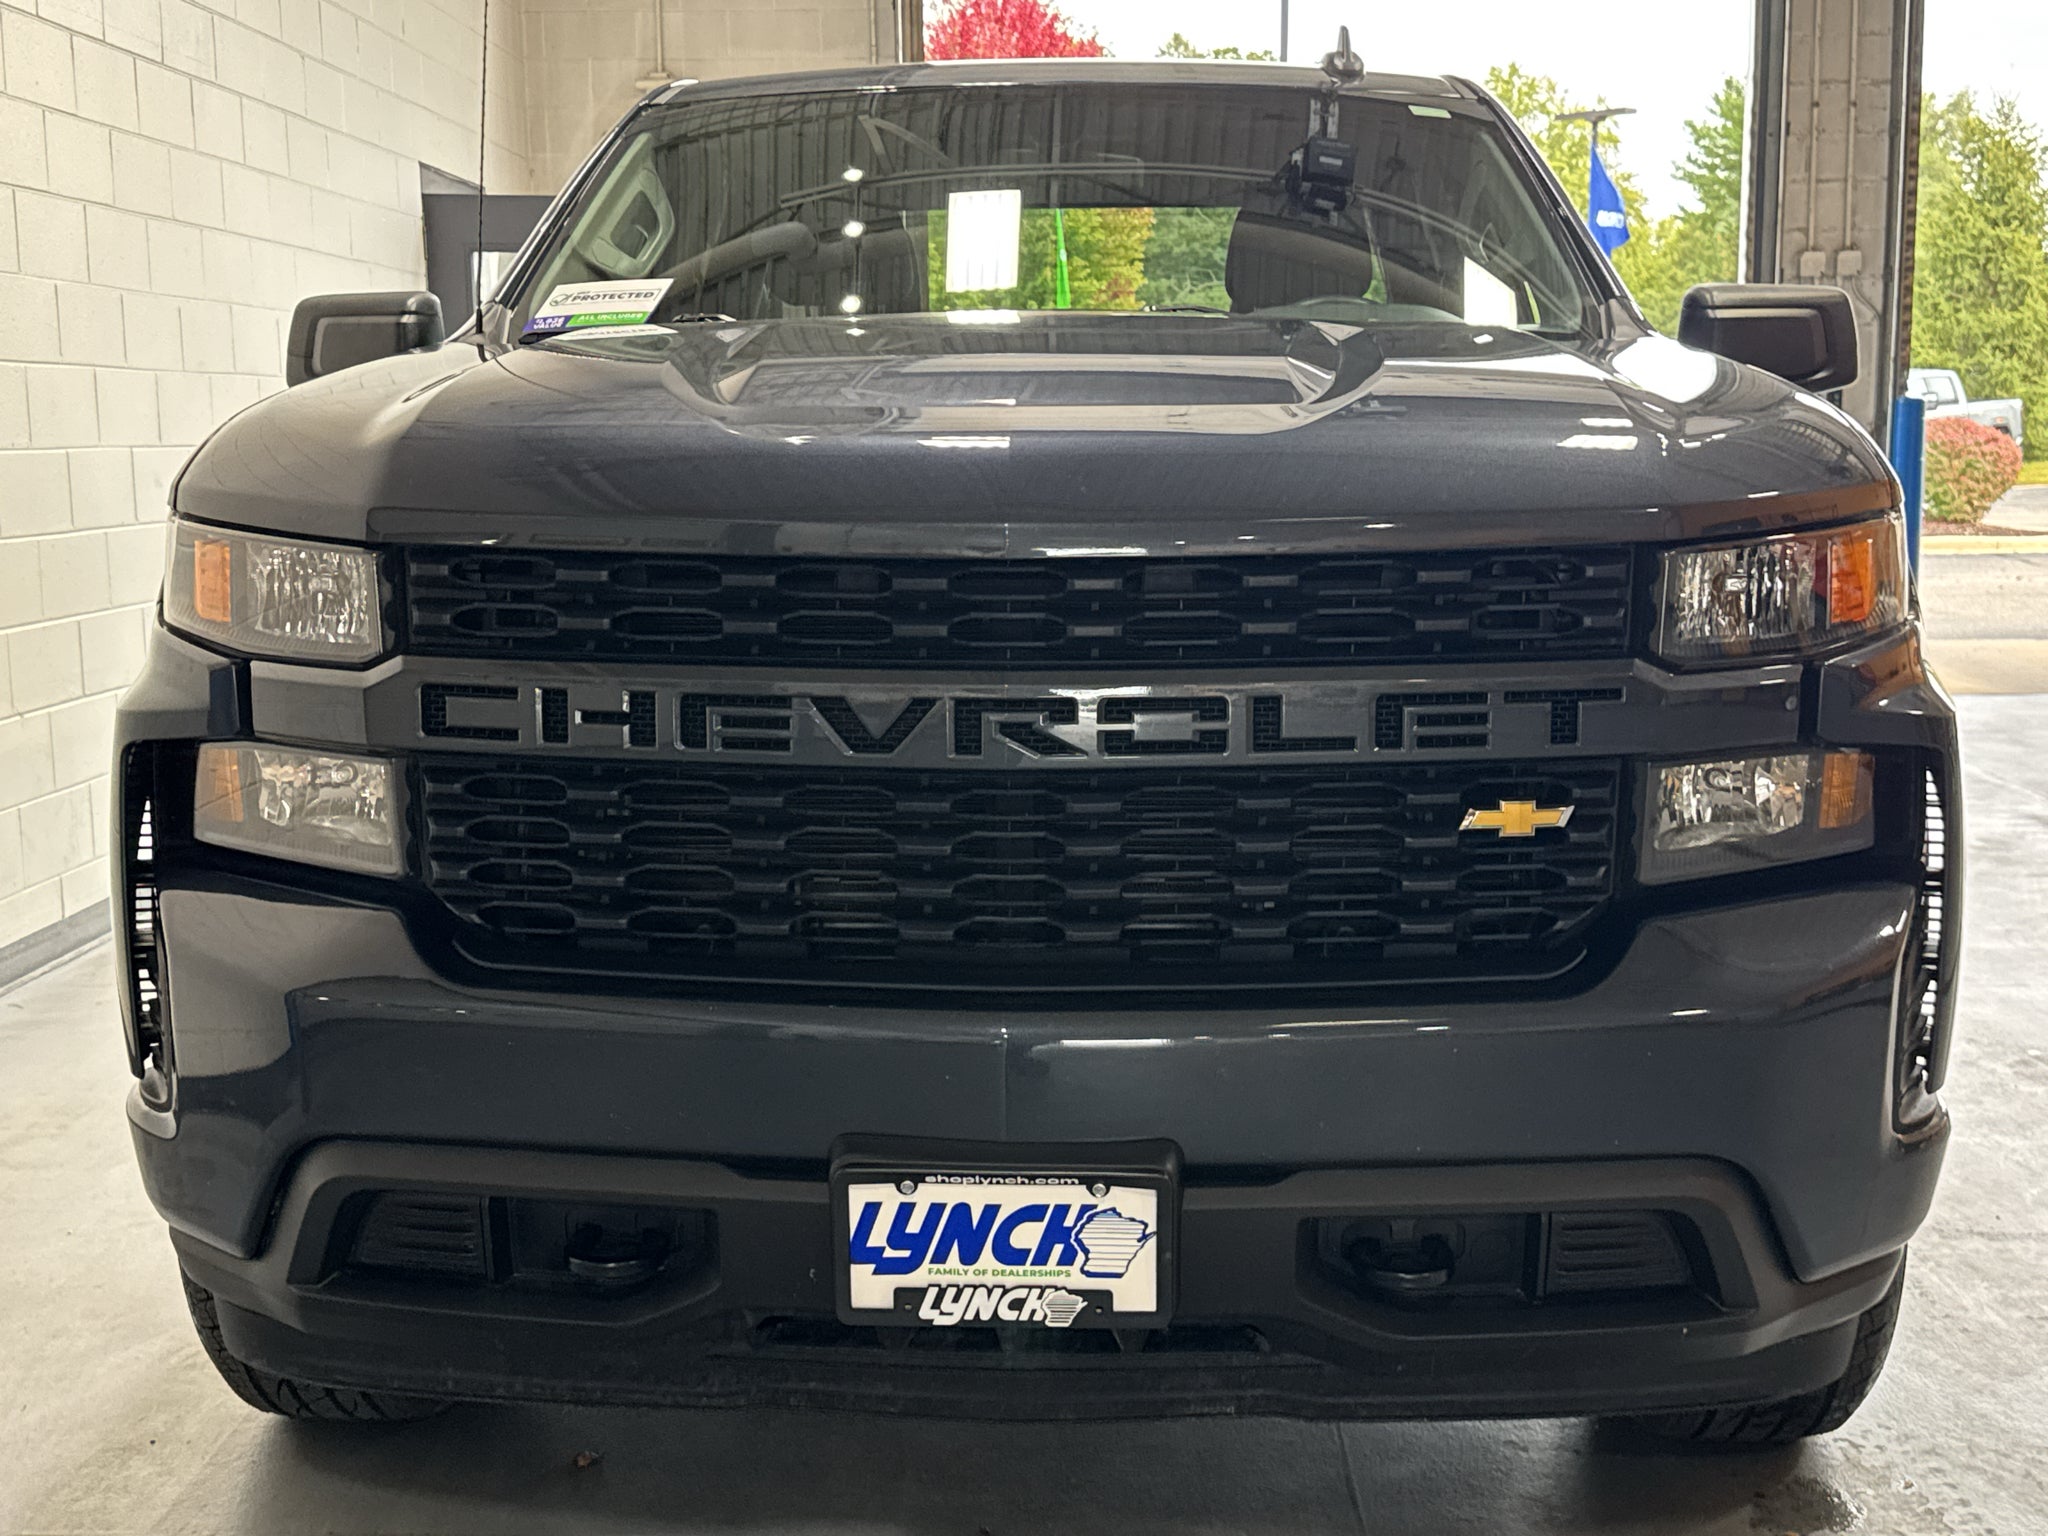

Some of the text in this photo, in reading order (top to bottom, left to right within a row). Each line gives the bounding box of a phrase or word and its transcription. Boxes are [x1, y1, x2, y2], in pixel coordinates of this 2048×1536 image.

[571, 291, 655, 302] PROTECTED
[418, 684, 1626, 758] CHEVROLET
[924, 1174, 1080, 1186] shoplynch.com
[849, 1201, 1098, 1276] LYNCH
[927, 1267, 1072, 1278] FAMILY OF DEALERSHIPS
[918, 1285, 1059, 1326] LYNCH
